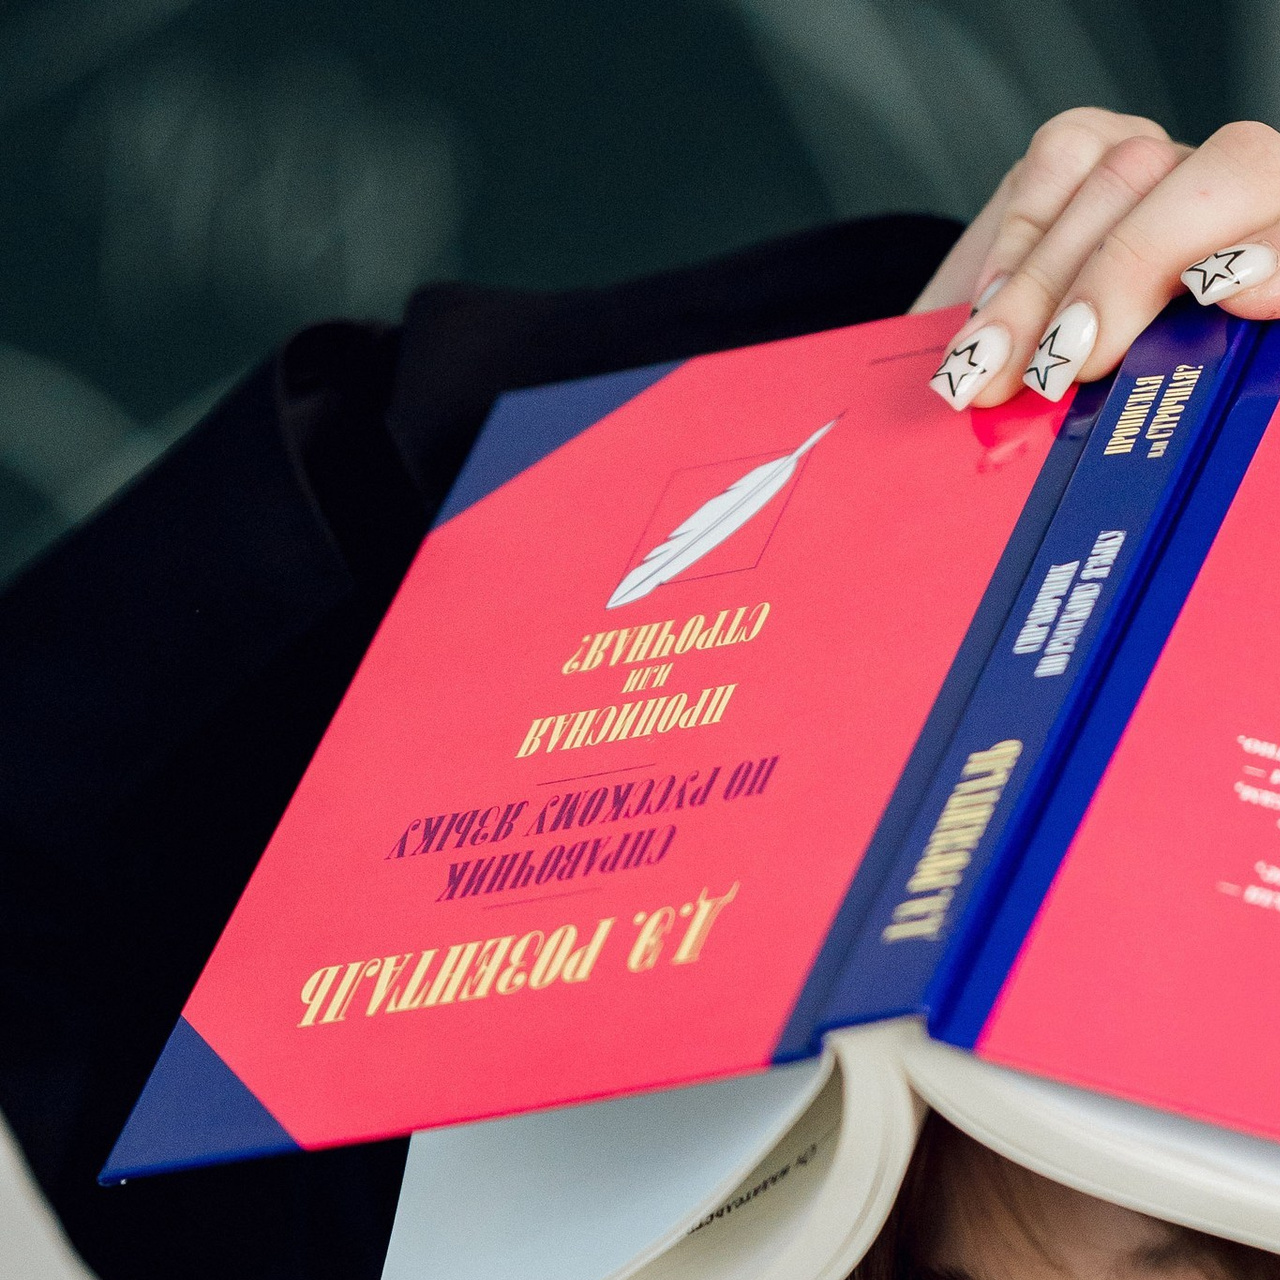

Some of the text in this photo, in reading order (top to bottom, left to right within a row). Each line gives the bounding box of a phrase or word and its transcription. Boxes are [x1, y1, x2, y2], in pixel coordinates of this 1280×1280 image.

[1102, 373, 1166, 456] ПРОПИСНАЯ
[1144, 363, 1205, 441] СТРОЧНАЯ?
[560, 600, 772, 676] СТРОЧНАЯ?
[514, 682, 738, 760] ПРОПИСНАЯ
[394, 754, 781, 860] ПО РУССКОМУ ЯЗЫКУ
[434, 823, 678, 904] СПРАВОЧНИК
[296, 916, 616, 1029] РОЗЕНТАЛЬ
